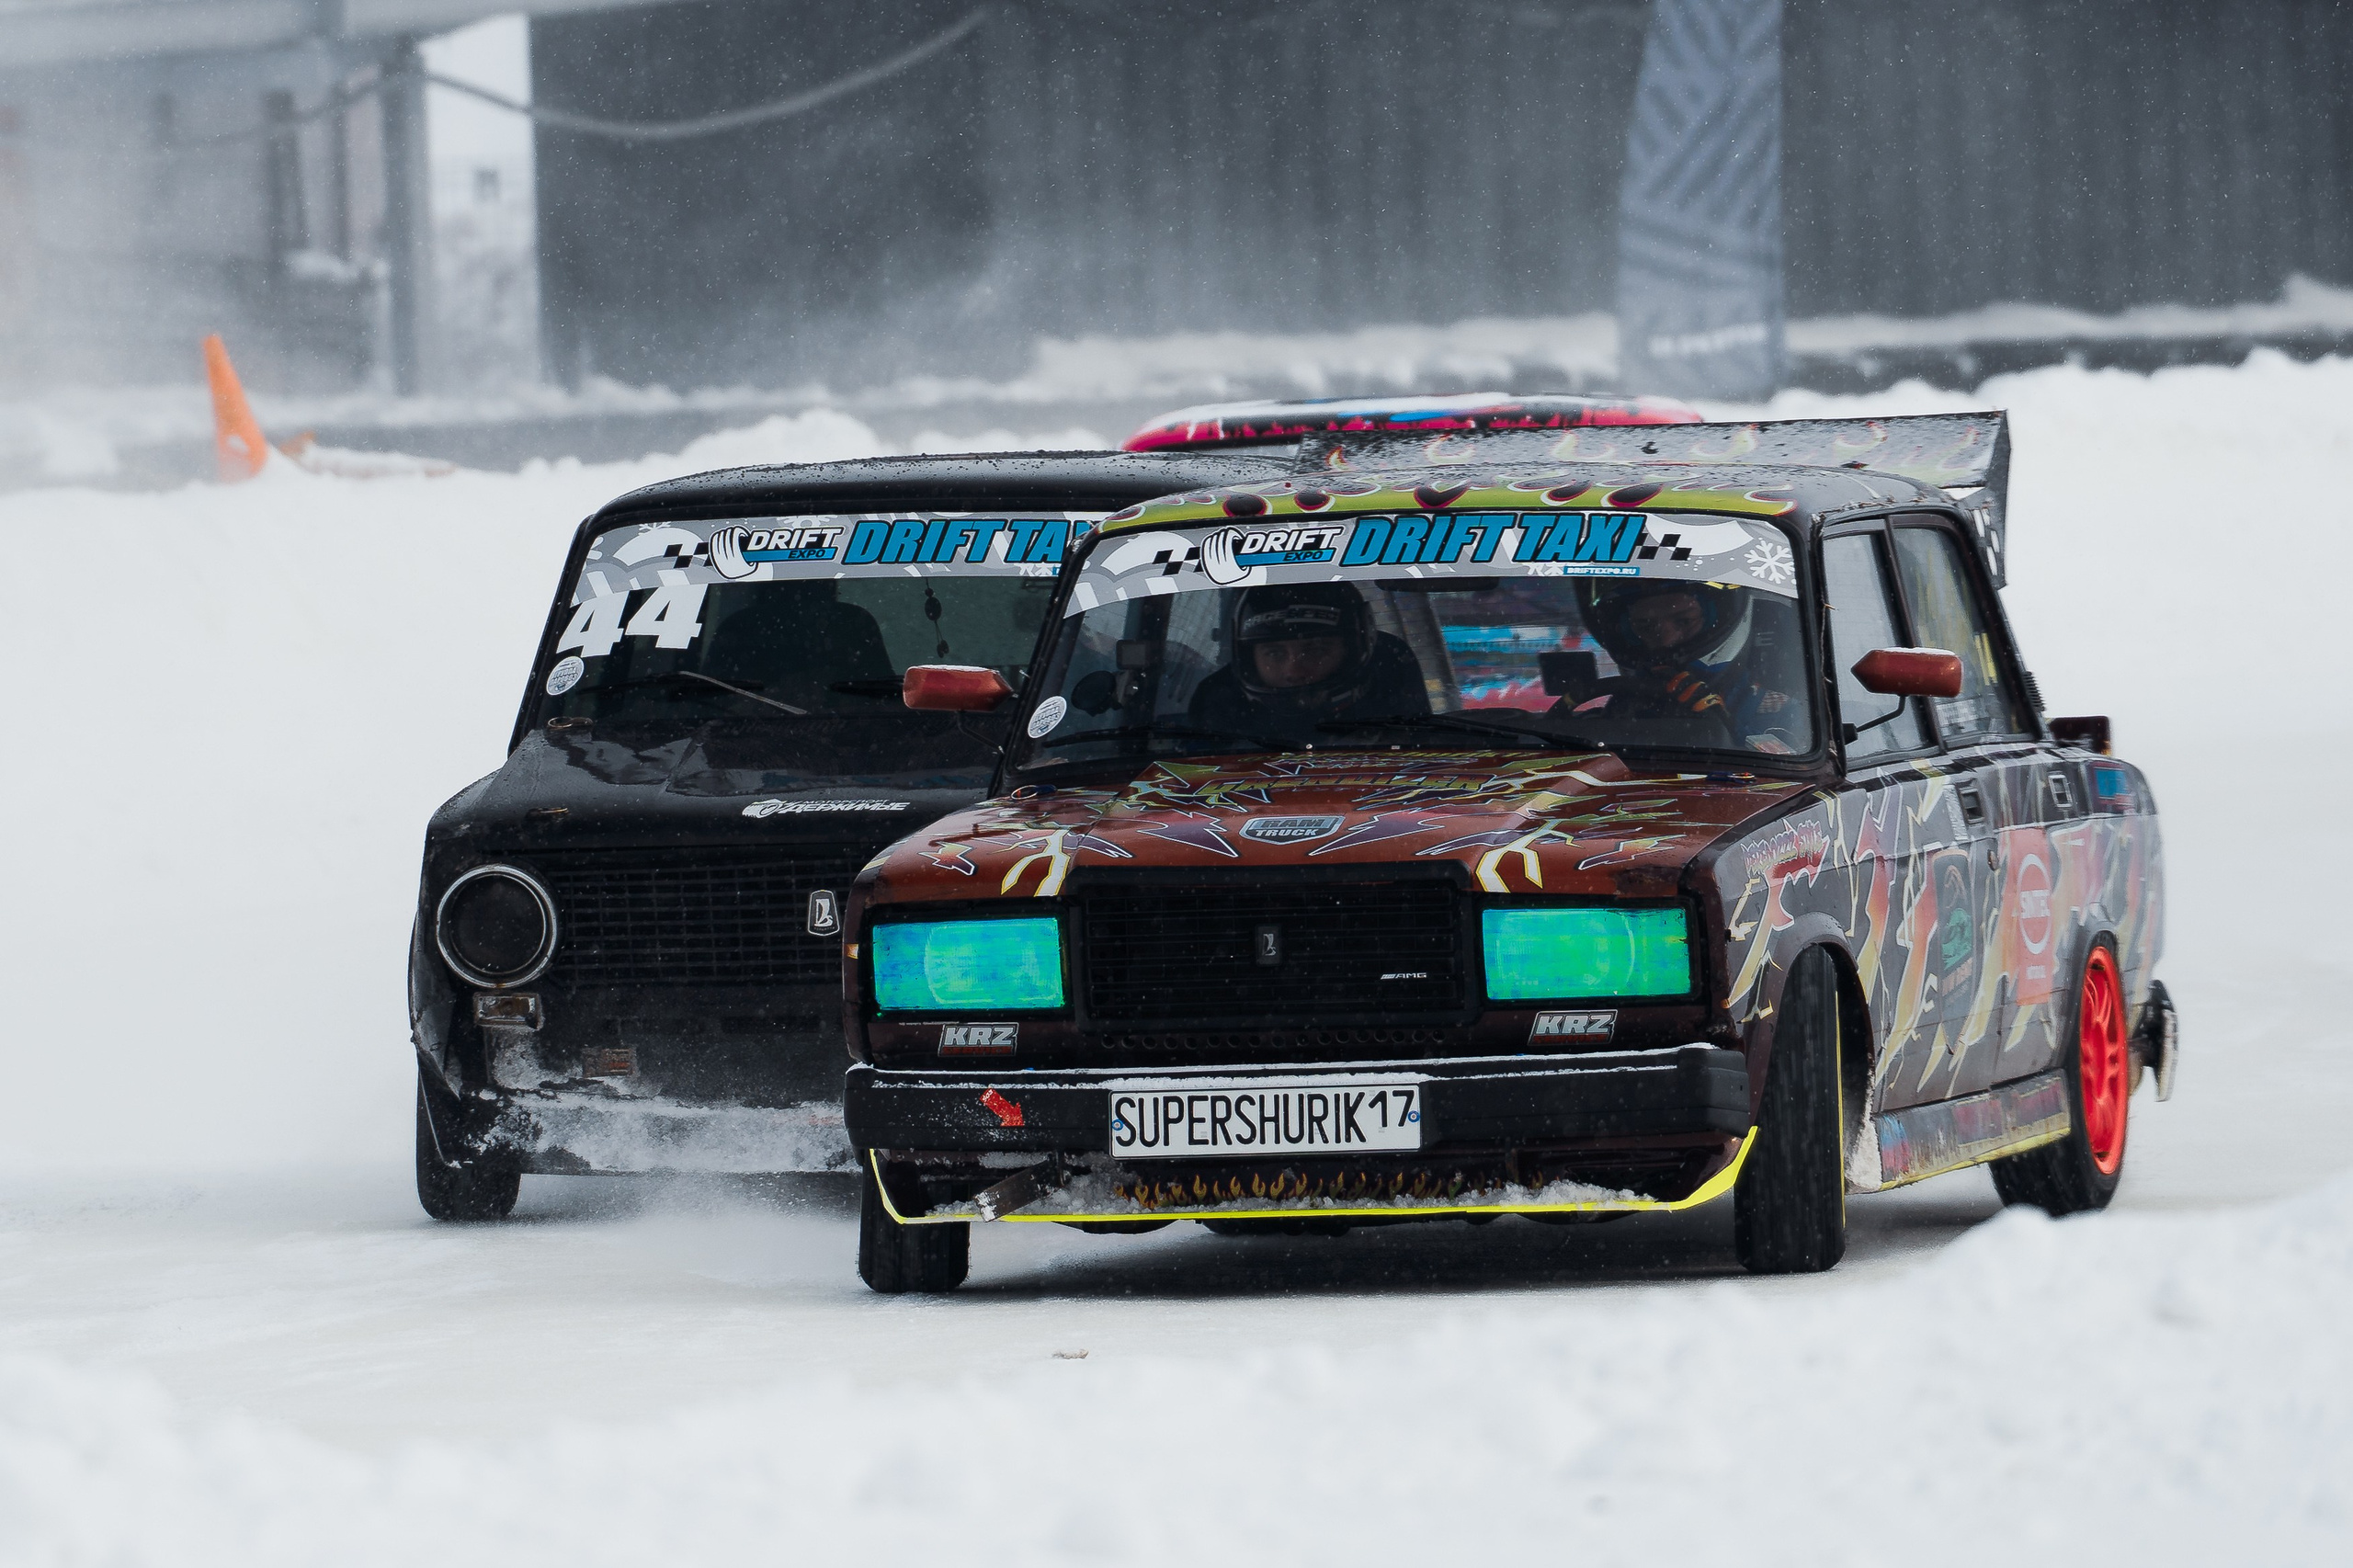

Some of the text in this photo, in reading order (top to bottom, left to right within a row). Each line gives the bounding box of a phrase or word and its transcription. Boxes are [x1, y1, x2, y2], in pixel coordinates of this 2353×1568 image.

[746, 528, 844, 551] DRIFT
[842, 519, 1092, 565] DRIFT TA
[1241, 527, 1343, 553] DRIFT
[1339, 513, 1646, 566] DRIFT TAXI
[788, 549, 826, 559] EXPO
[1283, 550, 1324, 562] EXPO
[1566, 566, 1637, 576] DRIFTEXPO.RU
[555, 584, 708, 658] 44
[1256, 828, 1319, 836] TRUCK
[1260, 819, 1325, 828] RAM
[1535, 1014, 1612, 1034] KRZ
[944, 1027, 1015, 1046] KRZ
